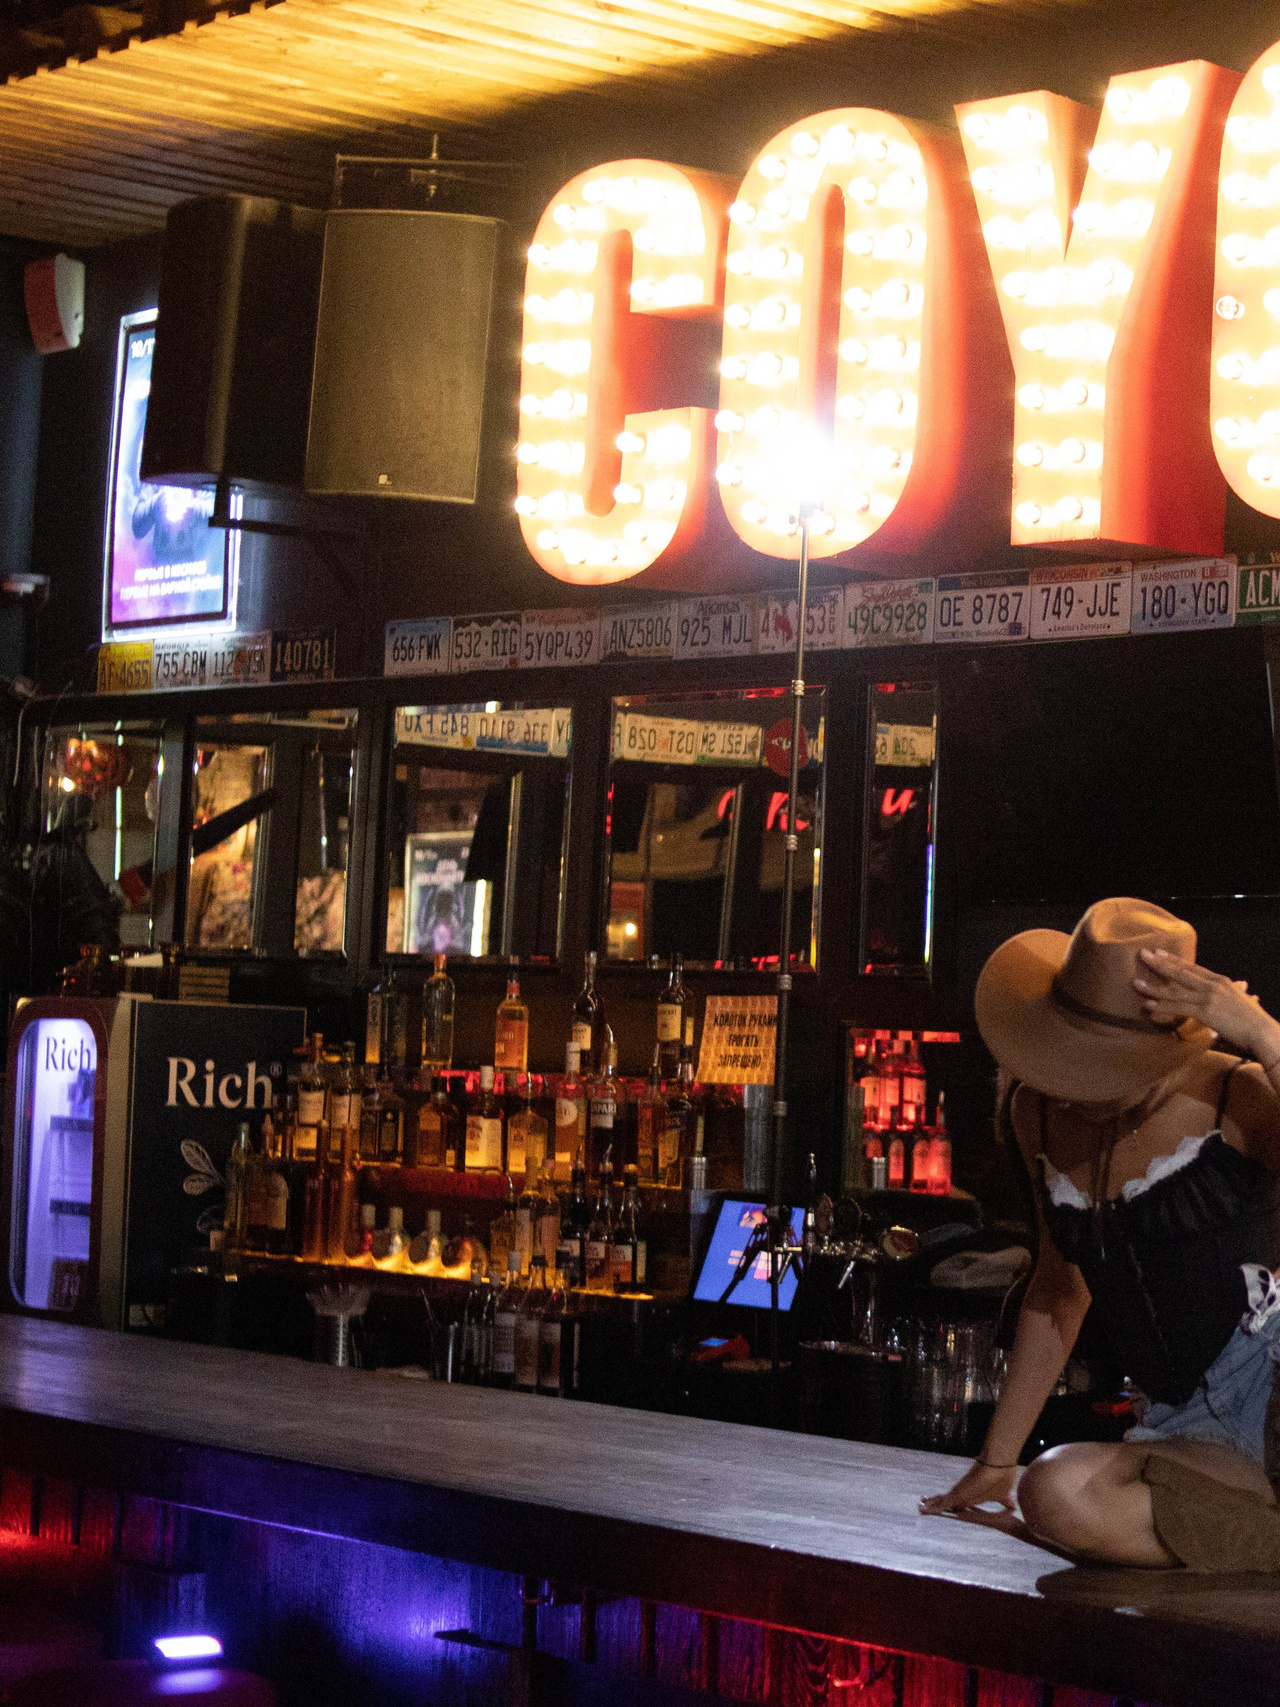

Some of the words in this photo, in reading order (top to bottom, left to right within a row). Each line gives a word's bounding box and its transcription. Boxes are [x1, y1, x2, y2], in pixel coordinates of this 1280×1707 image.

[1141, 568, 1197, 583] WASHINGTON
[972, 592, 1024, 626] 8787
[1041, 582, 1122, 621] 749-JJE
[680, 615, 712, 648] 925
[722, 613, 753, 645] MJL
[155, 651, 180, 680] 755
[275, 638, 331, 673] 140781
[119, 657, 150, 689] 4655
[44, 1036, 94, 1073] Rich
